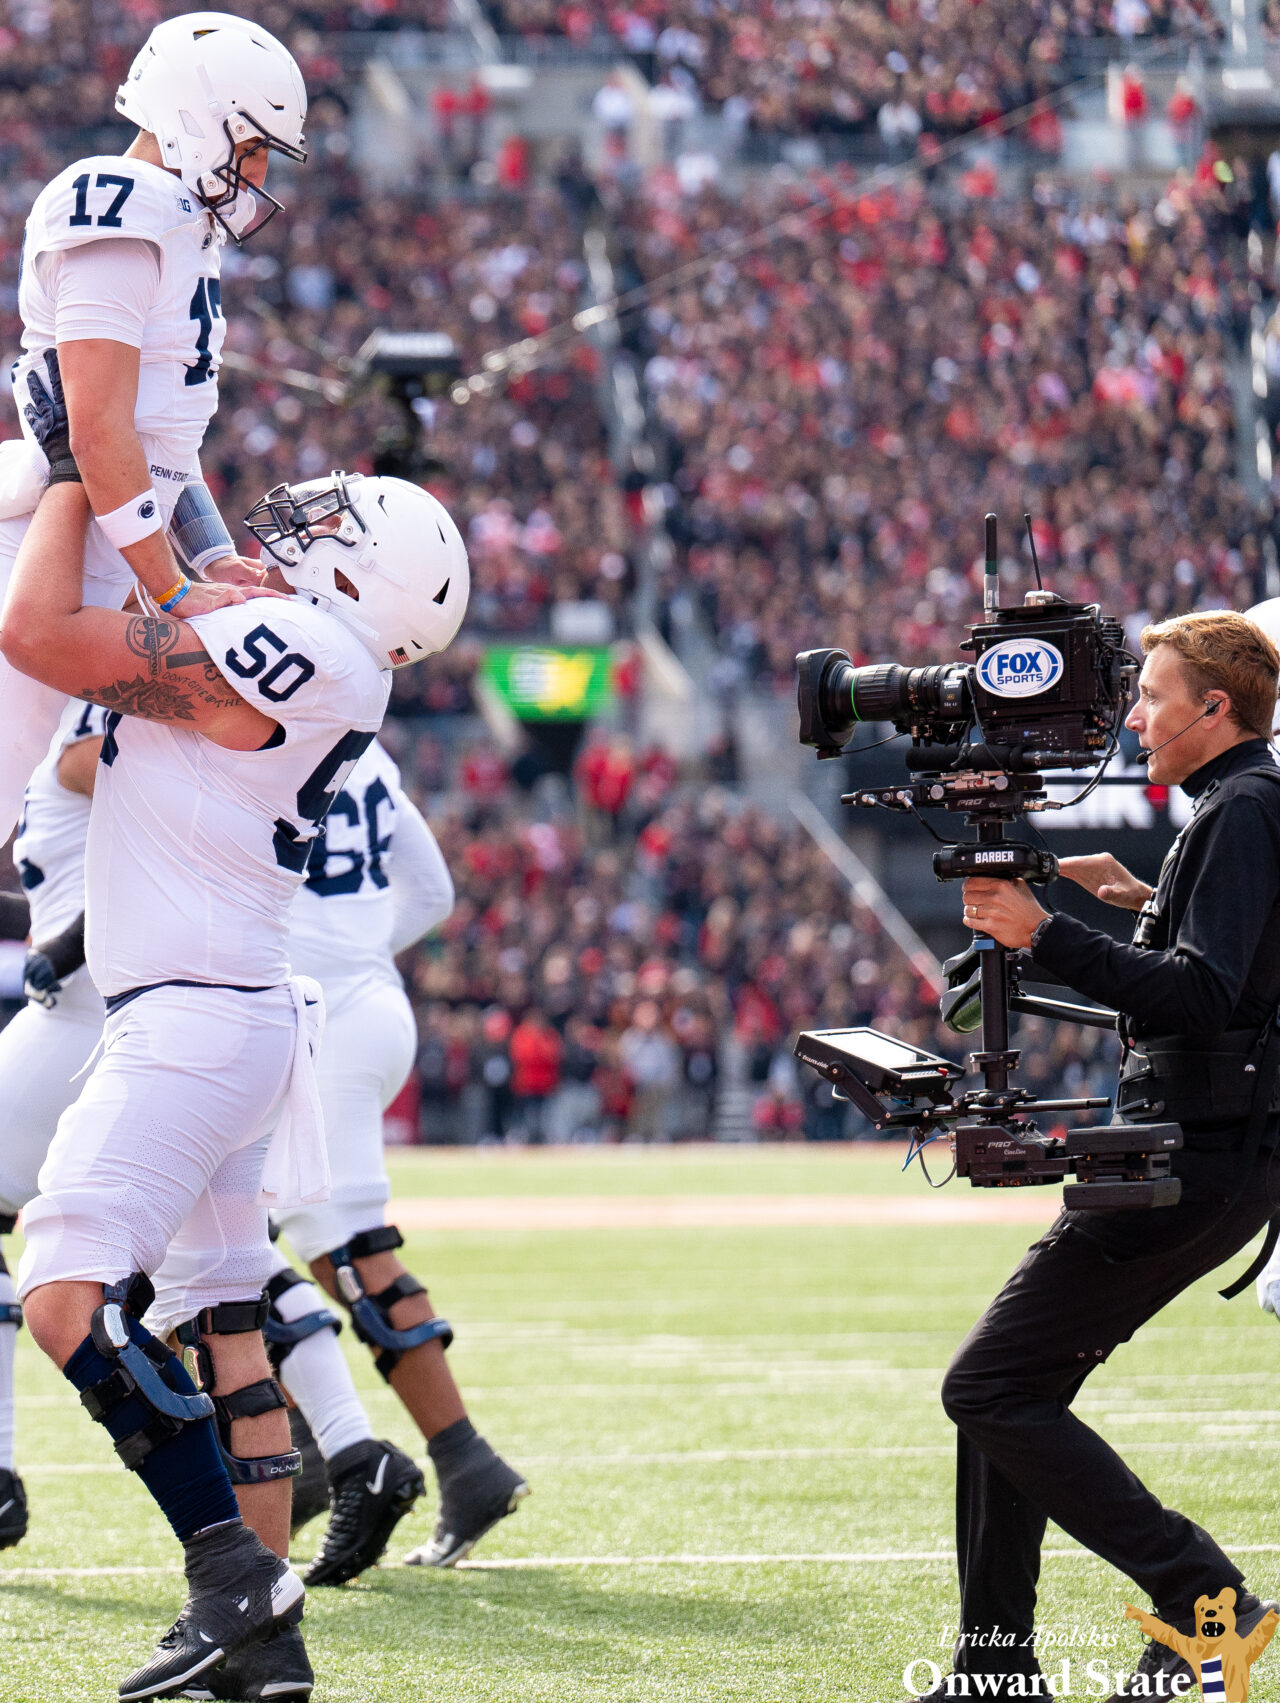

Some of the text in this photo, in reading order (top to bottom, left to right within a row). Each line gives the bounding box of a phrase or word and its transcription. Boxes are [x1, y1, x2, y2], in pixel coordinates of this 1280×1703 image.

[69, 173, 135, 228] 17
[150, 464, 173, 480] PENN
[225, 622, 316, 703] 50
[996, 651, 1043, 676] FOX
[997, 673, 1044, 685] SPORTS
[975, 850, 1015, 864] BARBER
